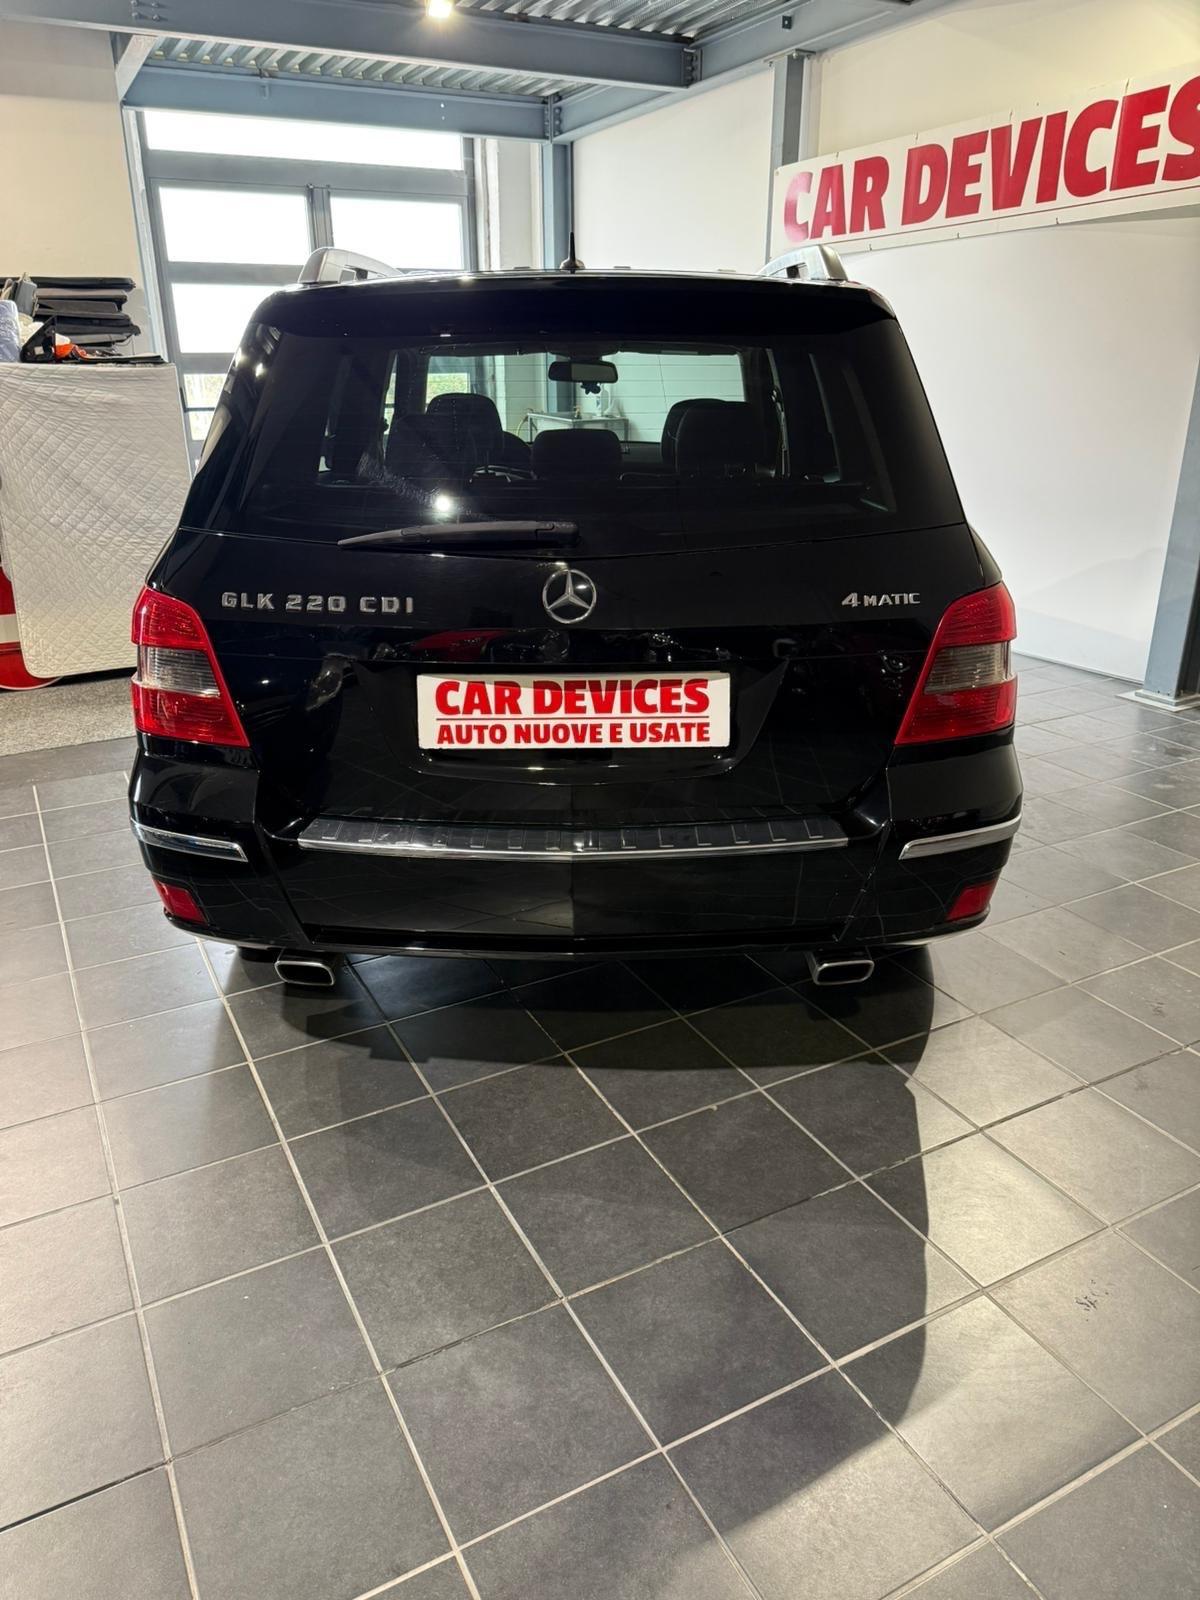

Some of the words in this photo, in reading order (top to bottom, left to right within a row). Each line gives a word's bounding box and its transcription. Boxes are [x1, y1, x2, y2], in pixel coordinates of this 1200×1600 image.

[783, 155, 890, 243] CAR
[901, 75, 1200, 226] DEVICES
[221, 591, 275, 610] GLK
[285, 594, 346, 613] 220
[359, 596, 414, 614] CDI
[435, 680, 522, 716] CAR
[533, 678, 709, 715] DEVICES
[436, 723, 507, 745] AUTO
[514, 723, 603, 744] NUOVE
[609, 723, 623, 743] E
[629, 722, 710, 743] USATE
